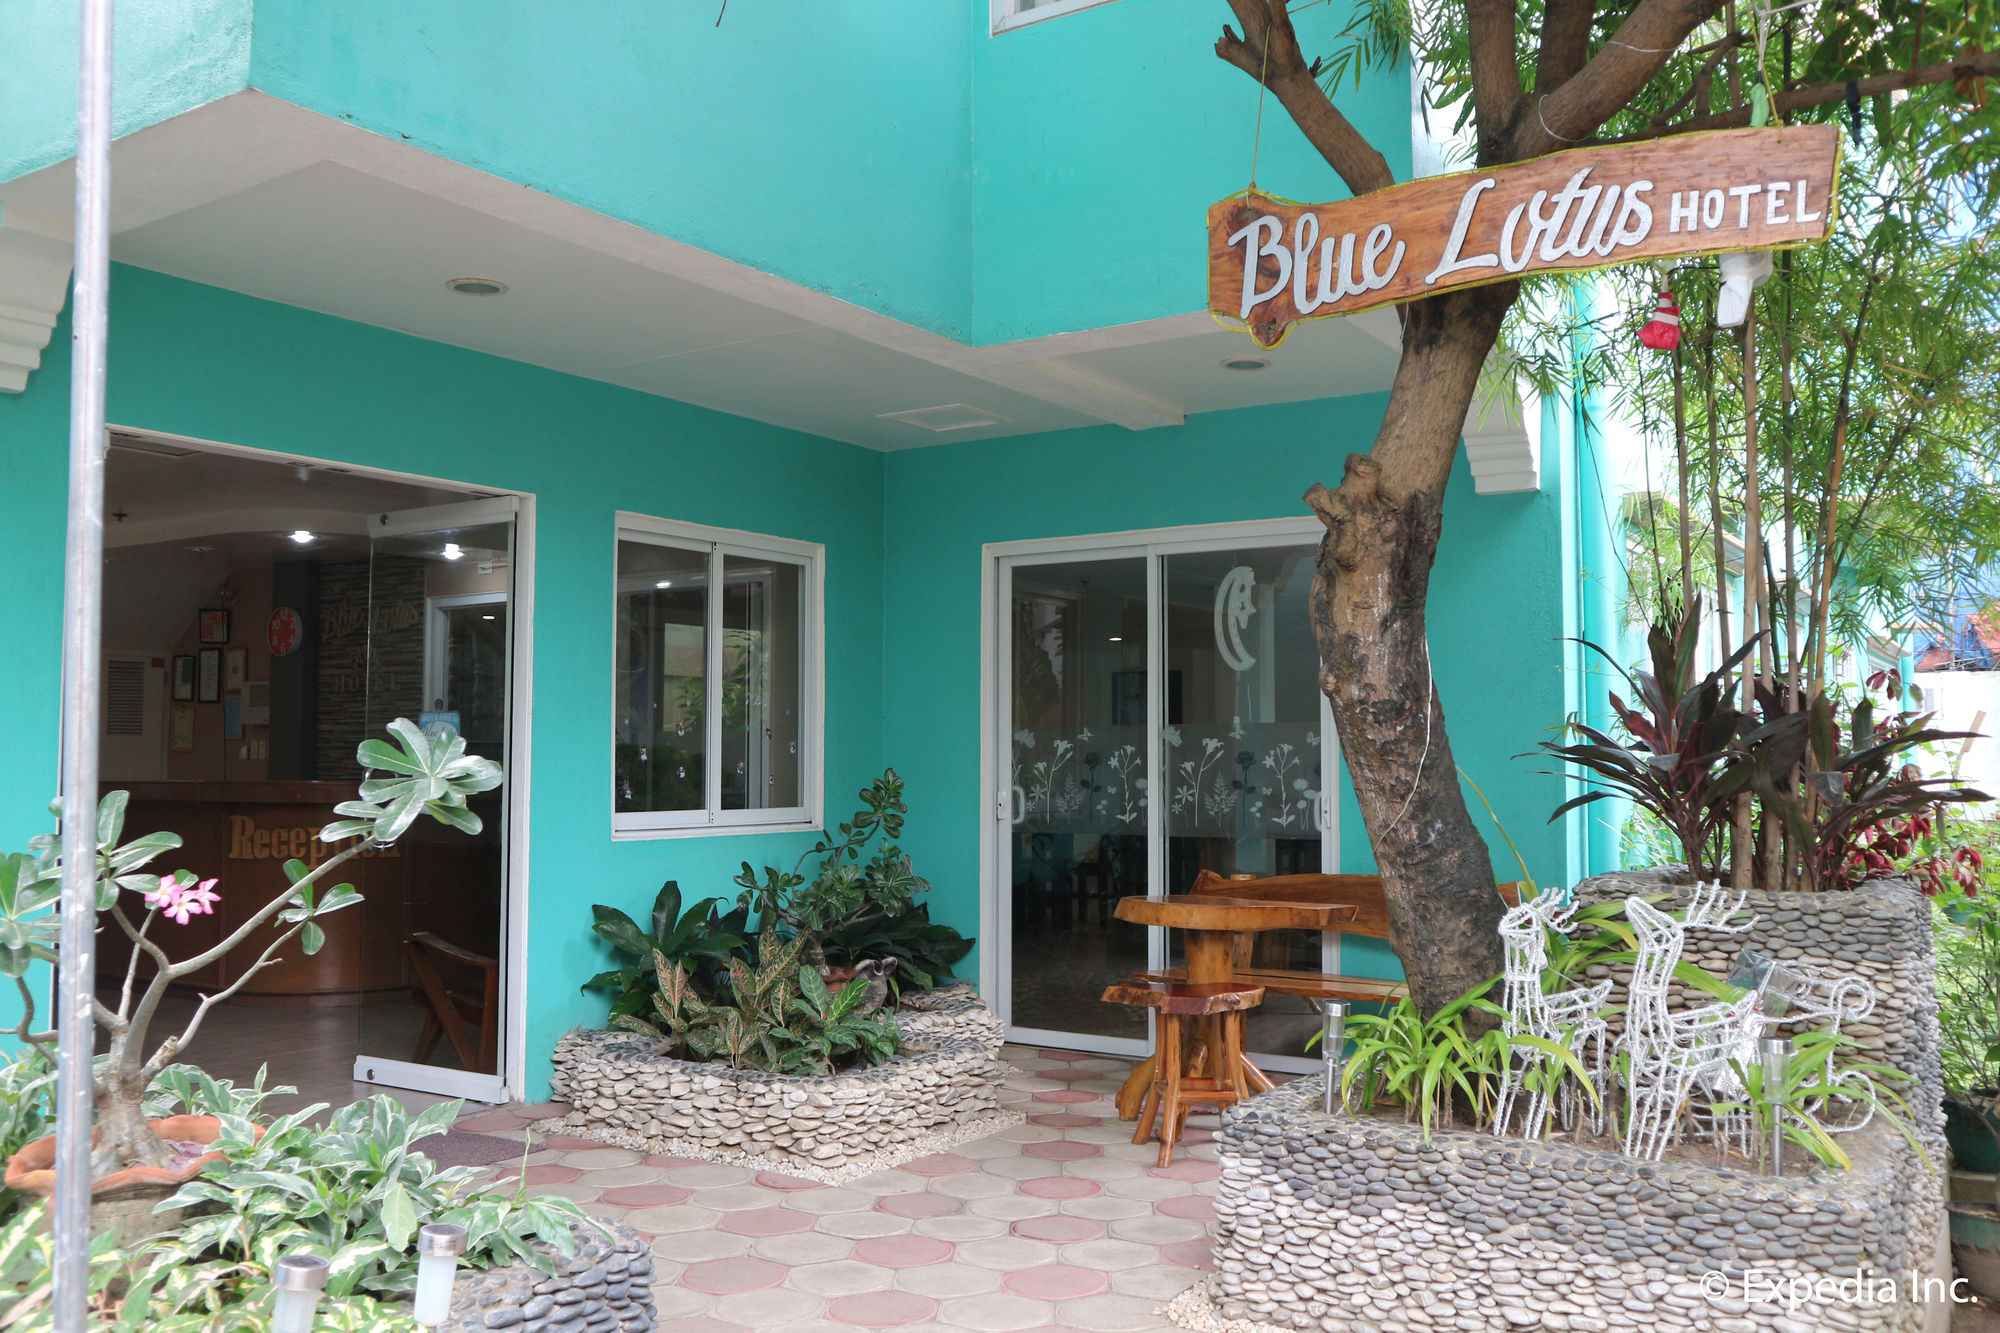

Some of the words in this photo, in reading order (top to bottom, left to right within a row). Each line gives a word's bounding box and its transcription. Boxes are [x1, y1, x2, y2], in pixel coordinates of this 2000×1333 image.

[1227, 211, 1406, 320] Blue
[1424, 166, 1655, 285] Lotus
[1669, 179, 1822, 233] HOTEL
